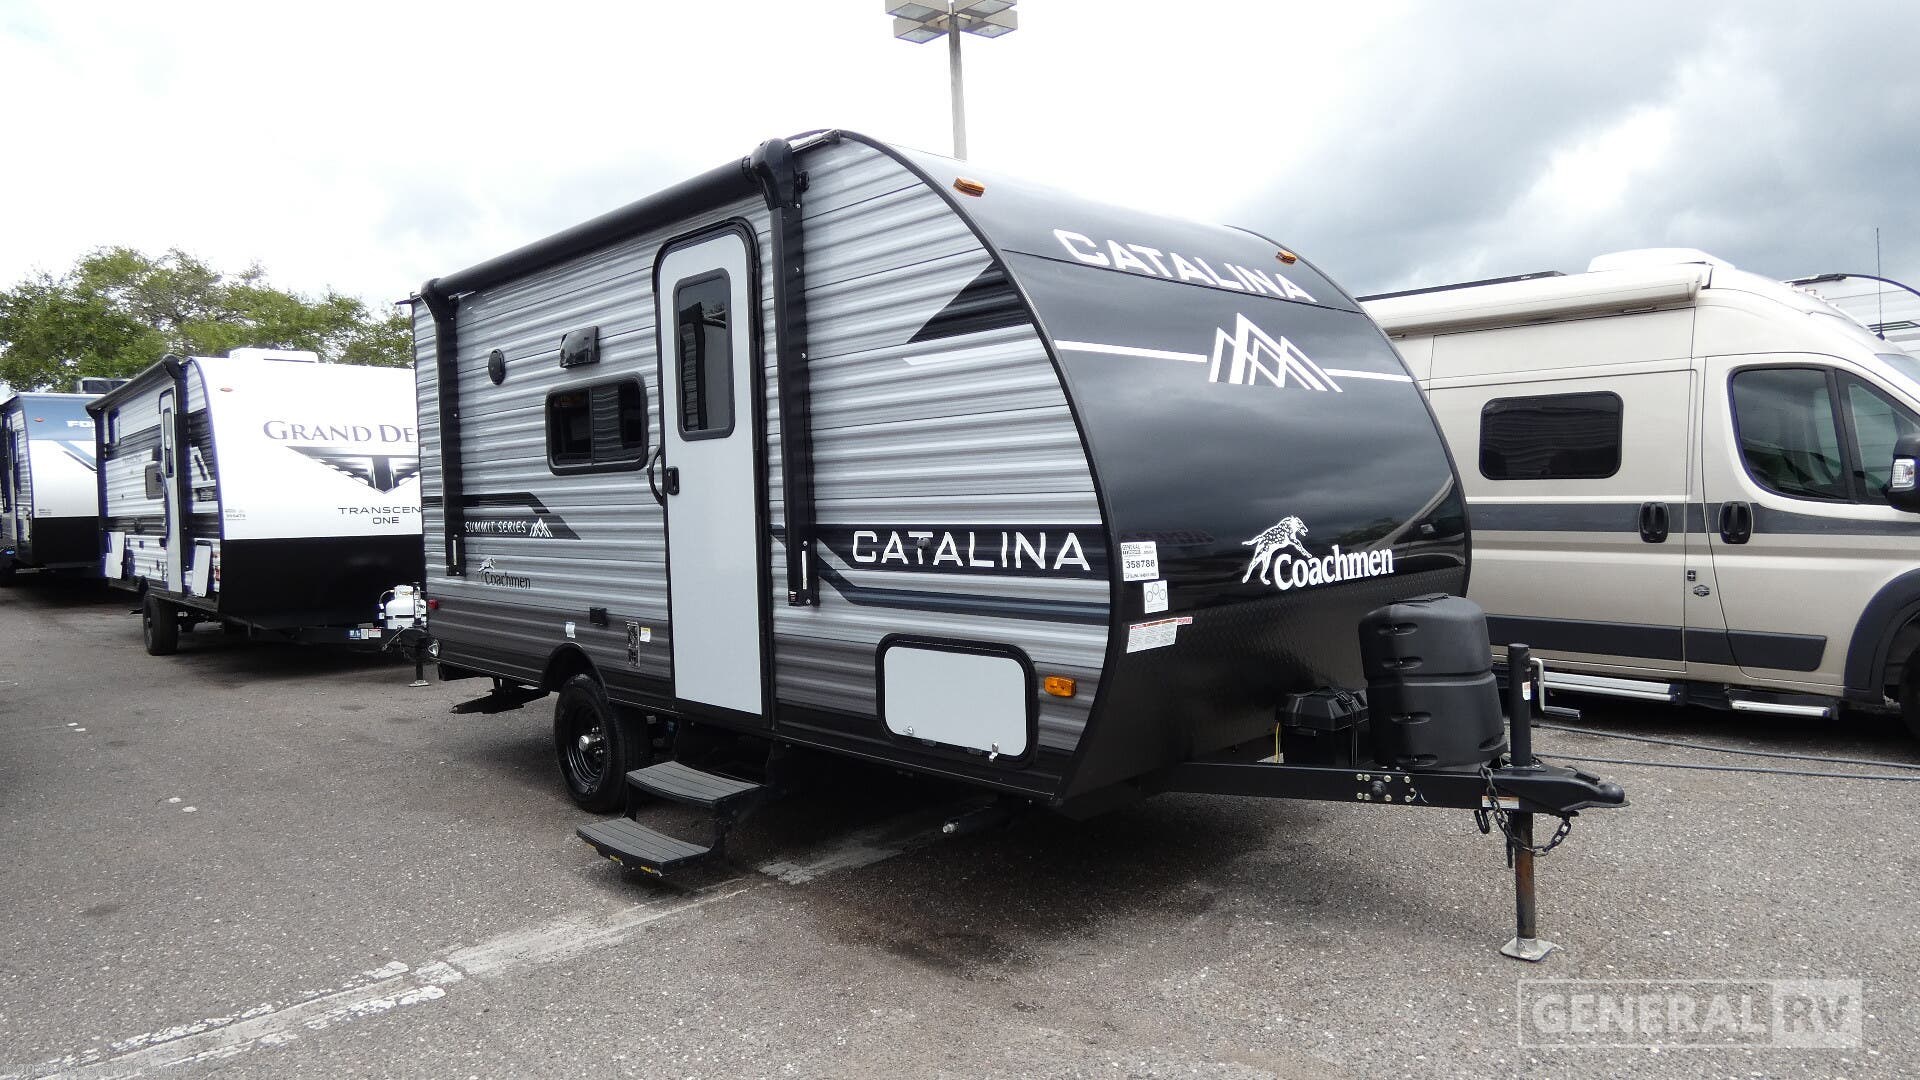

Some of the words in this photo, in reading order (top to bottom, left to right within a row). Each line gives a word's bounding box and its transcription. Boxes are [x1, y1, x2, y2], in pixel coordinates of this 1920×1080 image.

[1053, 228, 1318, 303] CATALINA
[263, 420, 372, 442] GRAND
[372, 516, 400, 525] ONE
[464, 521, 495, 533] SUMMIT
[497, 521, 527, 533] SERIES
[852, 530, 1092, 571] CATALINA
[1273, 544, 1395, 591] Coachmen
[483, 571, 531, 590] Coachmen
